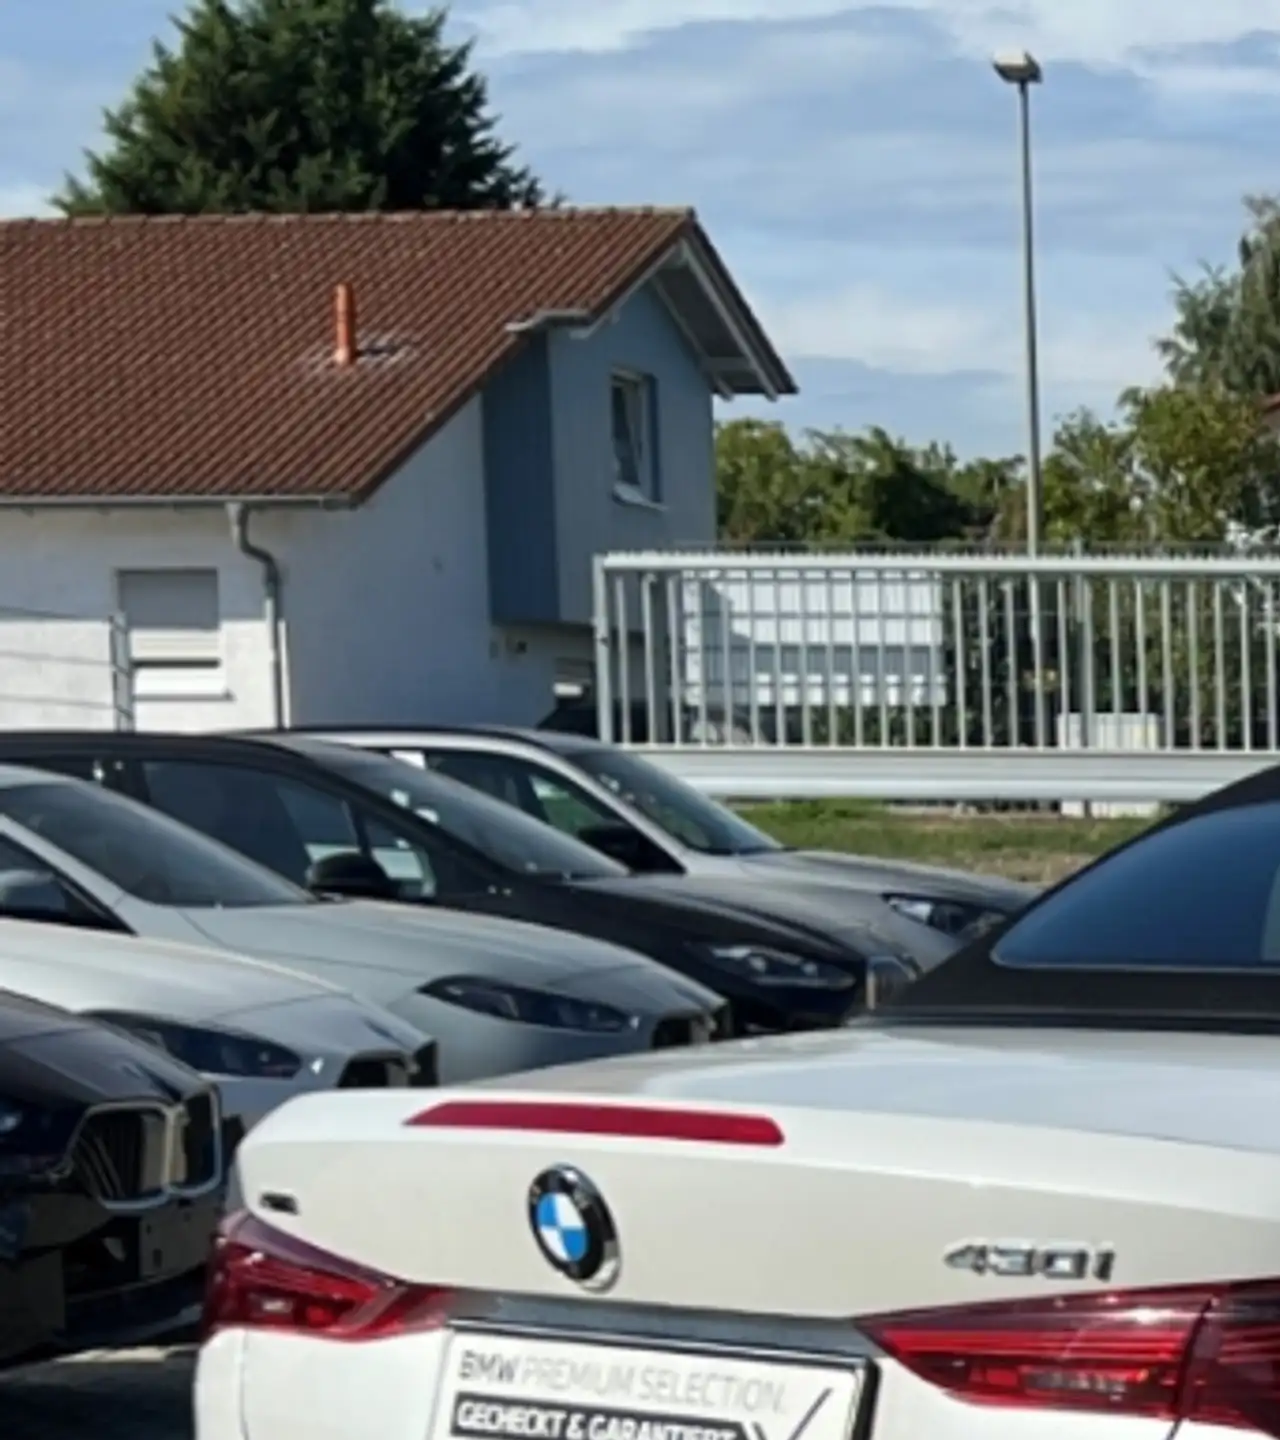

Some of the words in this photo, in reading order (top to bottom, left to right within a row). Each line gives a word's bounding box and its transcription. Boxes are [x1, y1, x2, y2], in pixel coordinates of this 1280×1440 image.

[459, 1349, 522, 1383] BMW
[522, 1356, 635, 1396] PREMIUM
[457, 1400, 567, 1439] GECHECKT
